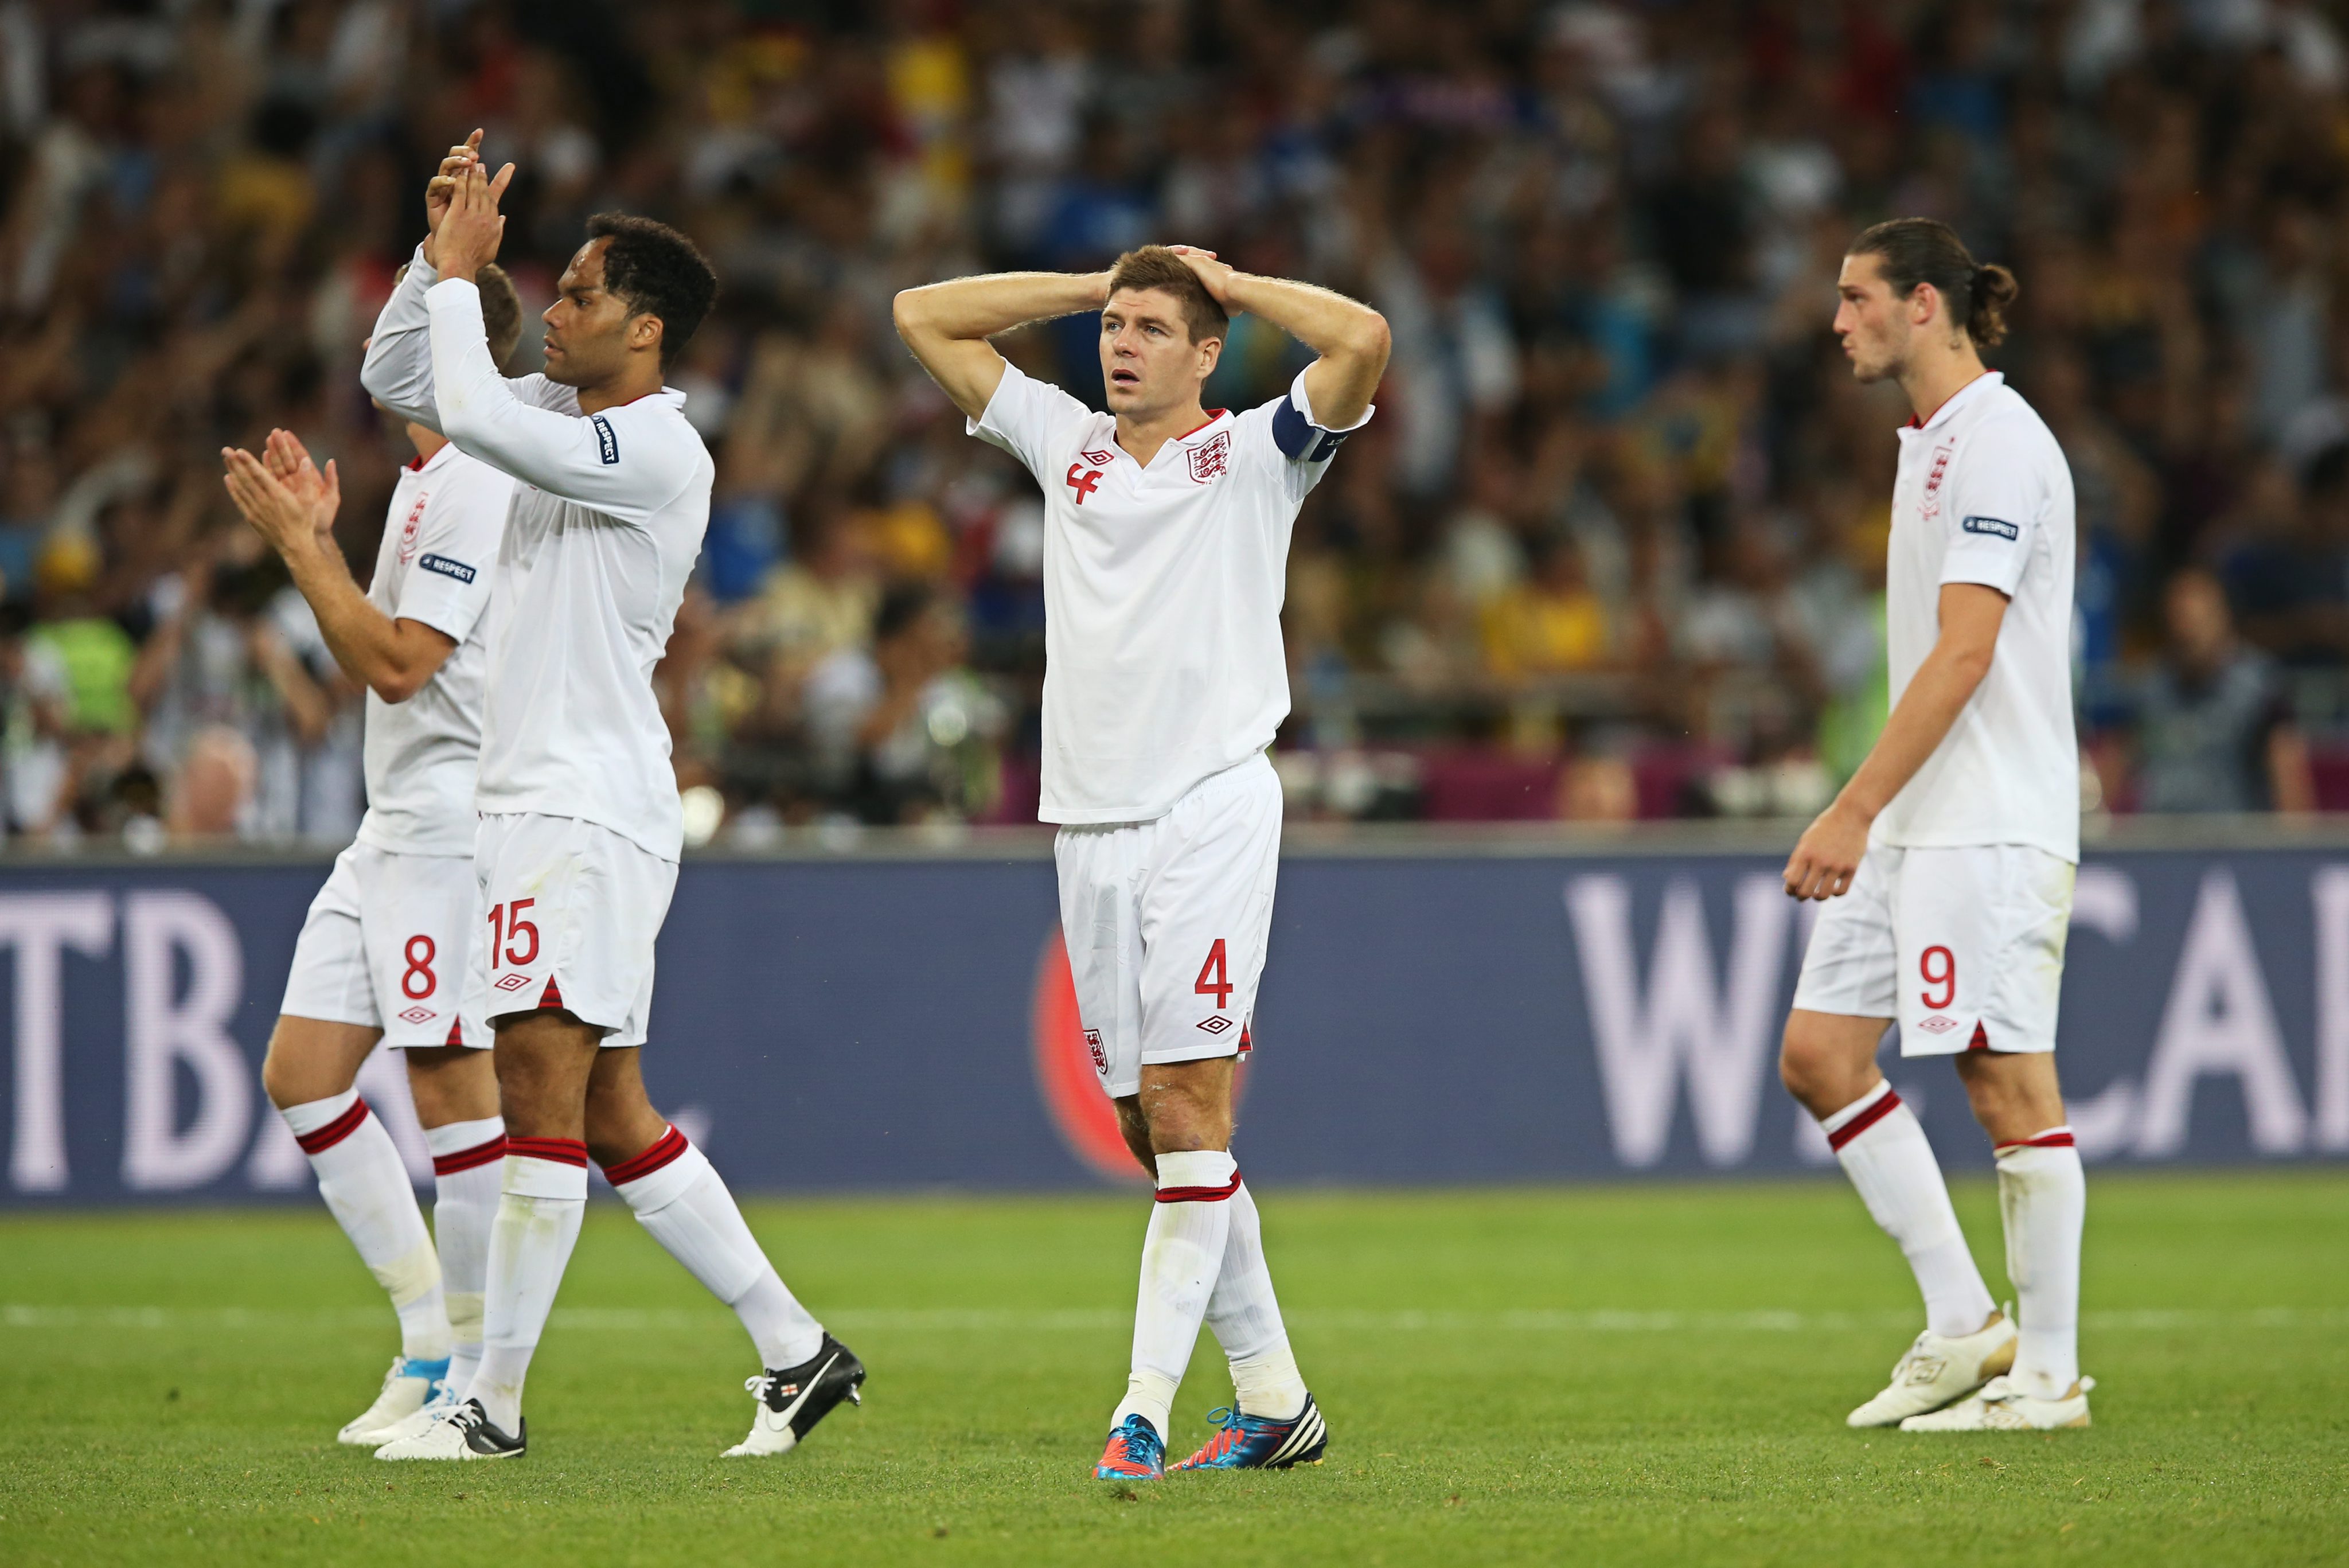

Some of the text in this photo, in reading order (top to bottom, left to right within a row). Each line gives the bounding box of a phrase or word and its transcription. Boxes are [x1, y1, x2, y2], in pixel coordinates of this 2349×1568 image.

[596, 422, 615, 461] RESPECT
[1067, 463, 1104, 505] 4
[1977, 520, 2017, 538] RESPECT
[433, 559, 474, 580] RESPECT
[487, 897, 540, 970] 15
[401, 934, 436, 1000] 8
[1195, 938, 1233, 1009] 4
[1920, 945, 1955, 1009] 9
